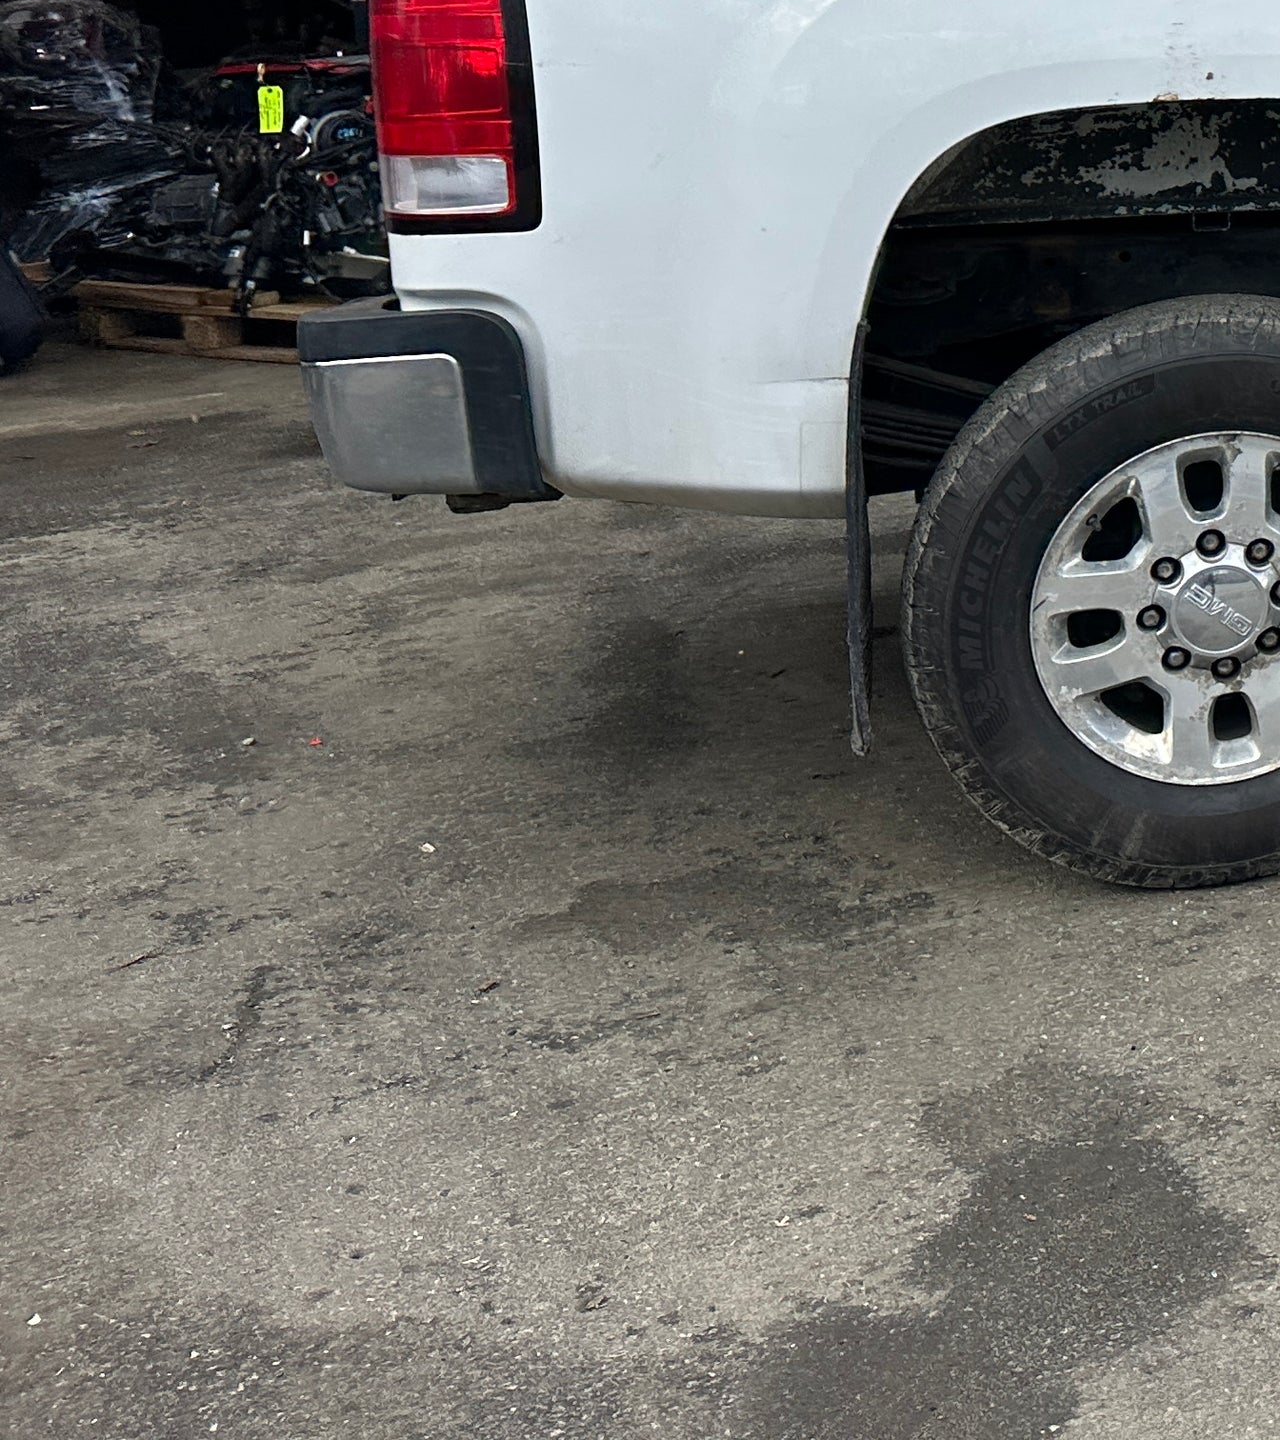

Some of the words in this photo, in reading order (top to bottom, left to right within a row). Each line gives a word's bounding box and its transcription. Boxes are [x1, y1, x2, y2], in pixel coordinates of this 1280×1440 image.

[1052, 405, 1089, 443] LTX
[956, 471, 1035, 672] MICHELIN
[1183, 582, 1253, 637] GMC
